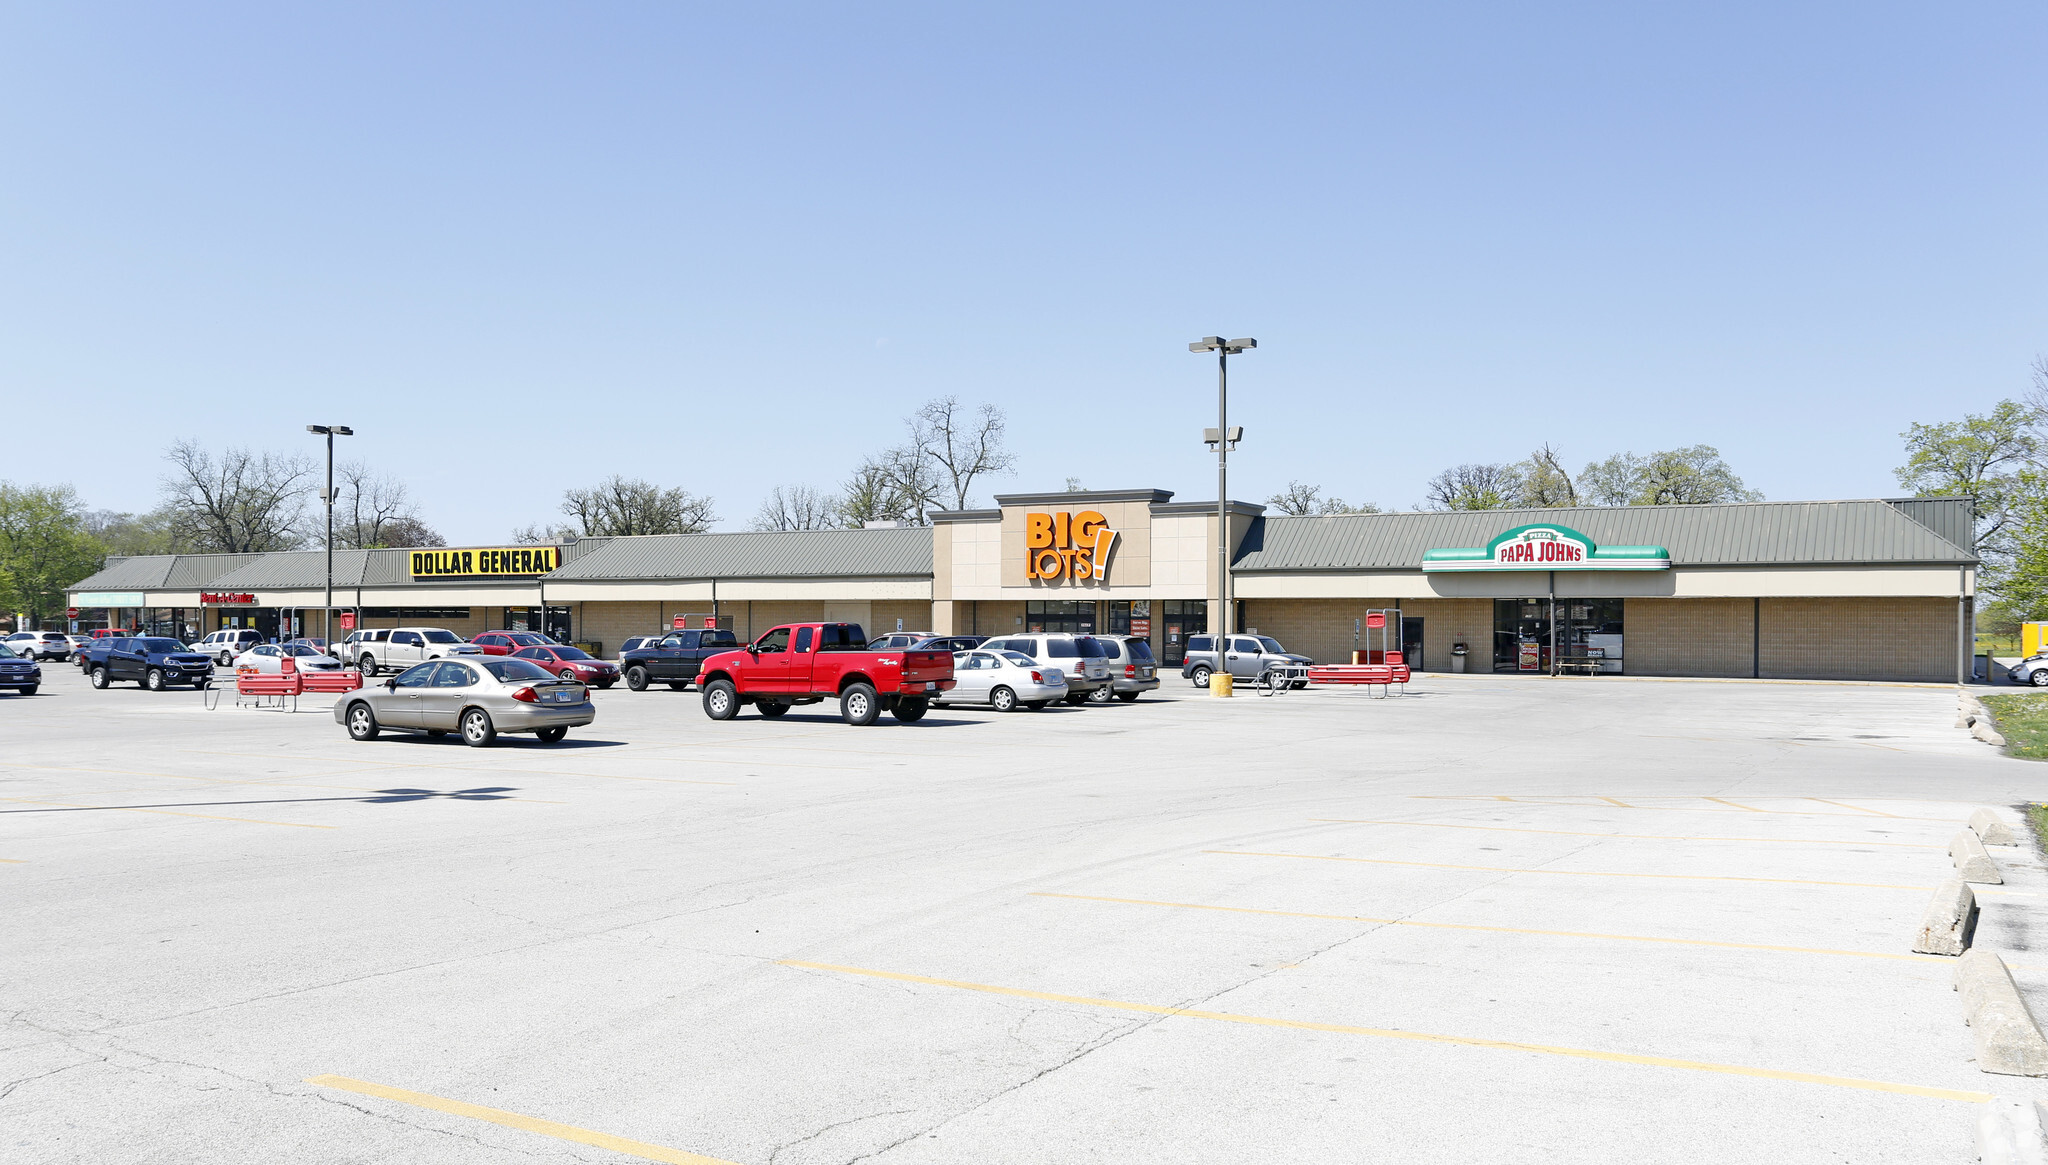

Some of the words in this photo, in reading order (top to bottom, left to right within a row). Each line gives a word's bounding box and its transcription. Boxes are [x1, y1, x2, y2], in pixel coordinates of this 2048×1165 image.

[1026, 510, 1107, 548] BIG
[413, 551, 473, 574] DOLLAR
[479, 550, 553, 573] GENERAL
[1501, 542, 1534, 562] PAPA
[1537, 541, 1581, 562] JOHNS
